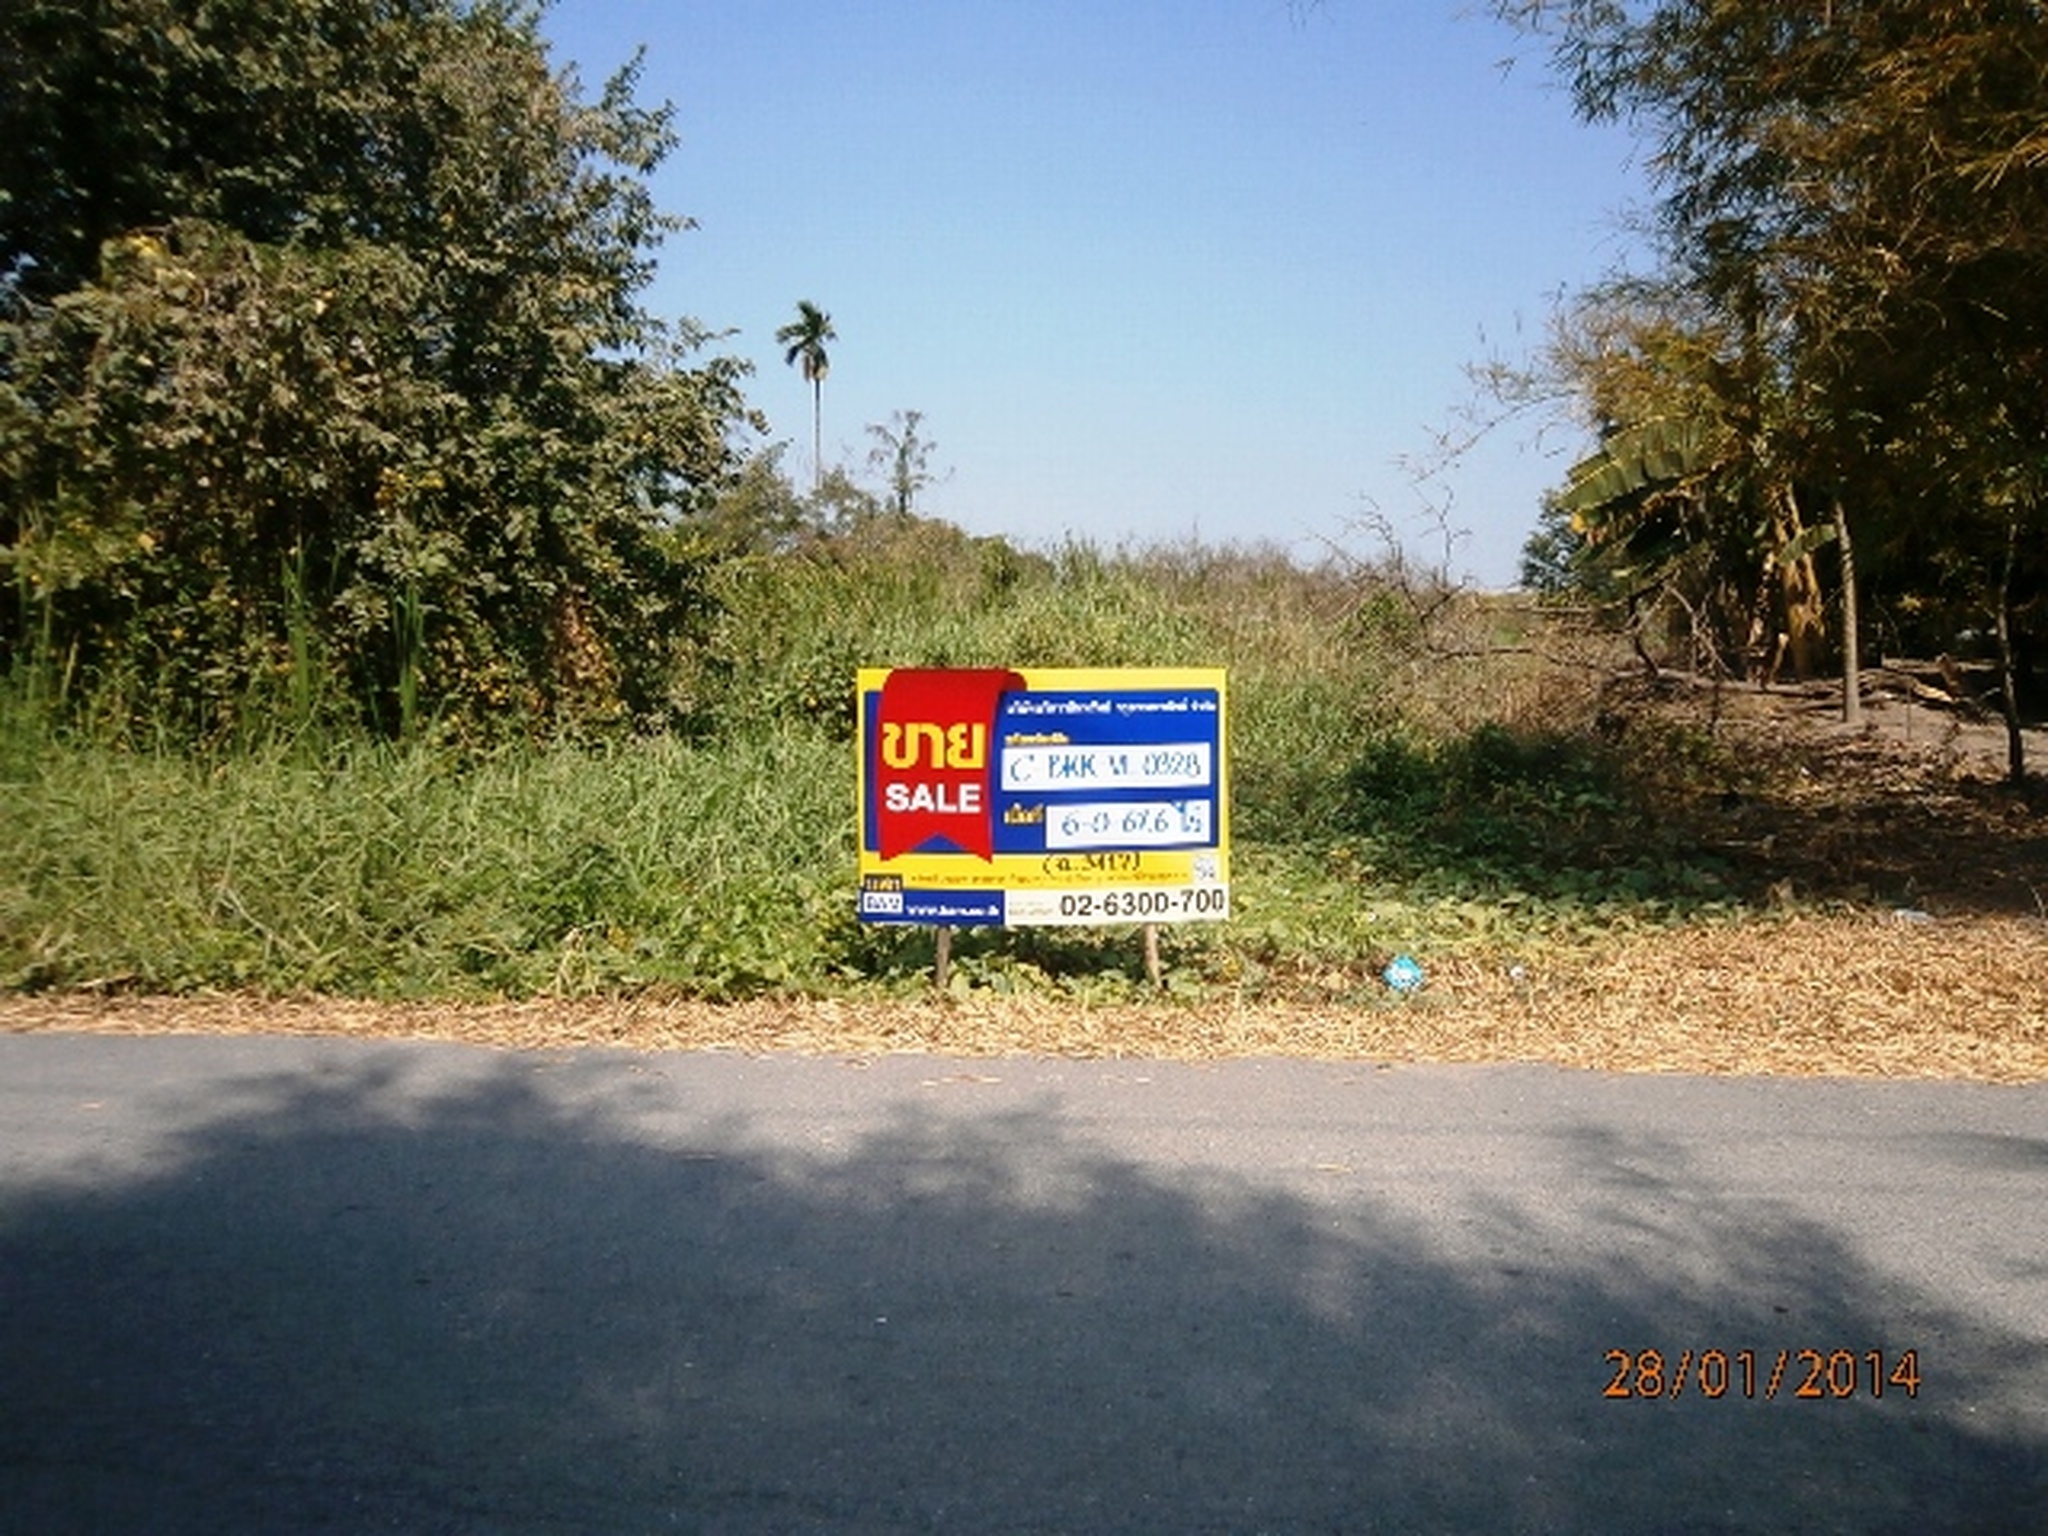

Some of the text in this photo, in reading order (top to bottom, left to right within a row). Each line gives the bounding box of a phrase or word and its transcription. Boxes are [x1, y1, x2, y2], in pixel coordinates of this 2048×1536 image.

[883, 722, 985, 769] ขาย
[885, 783, 982, 813] SALE
[1059, 888, 1225, 917] 02-6300-700
